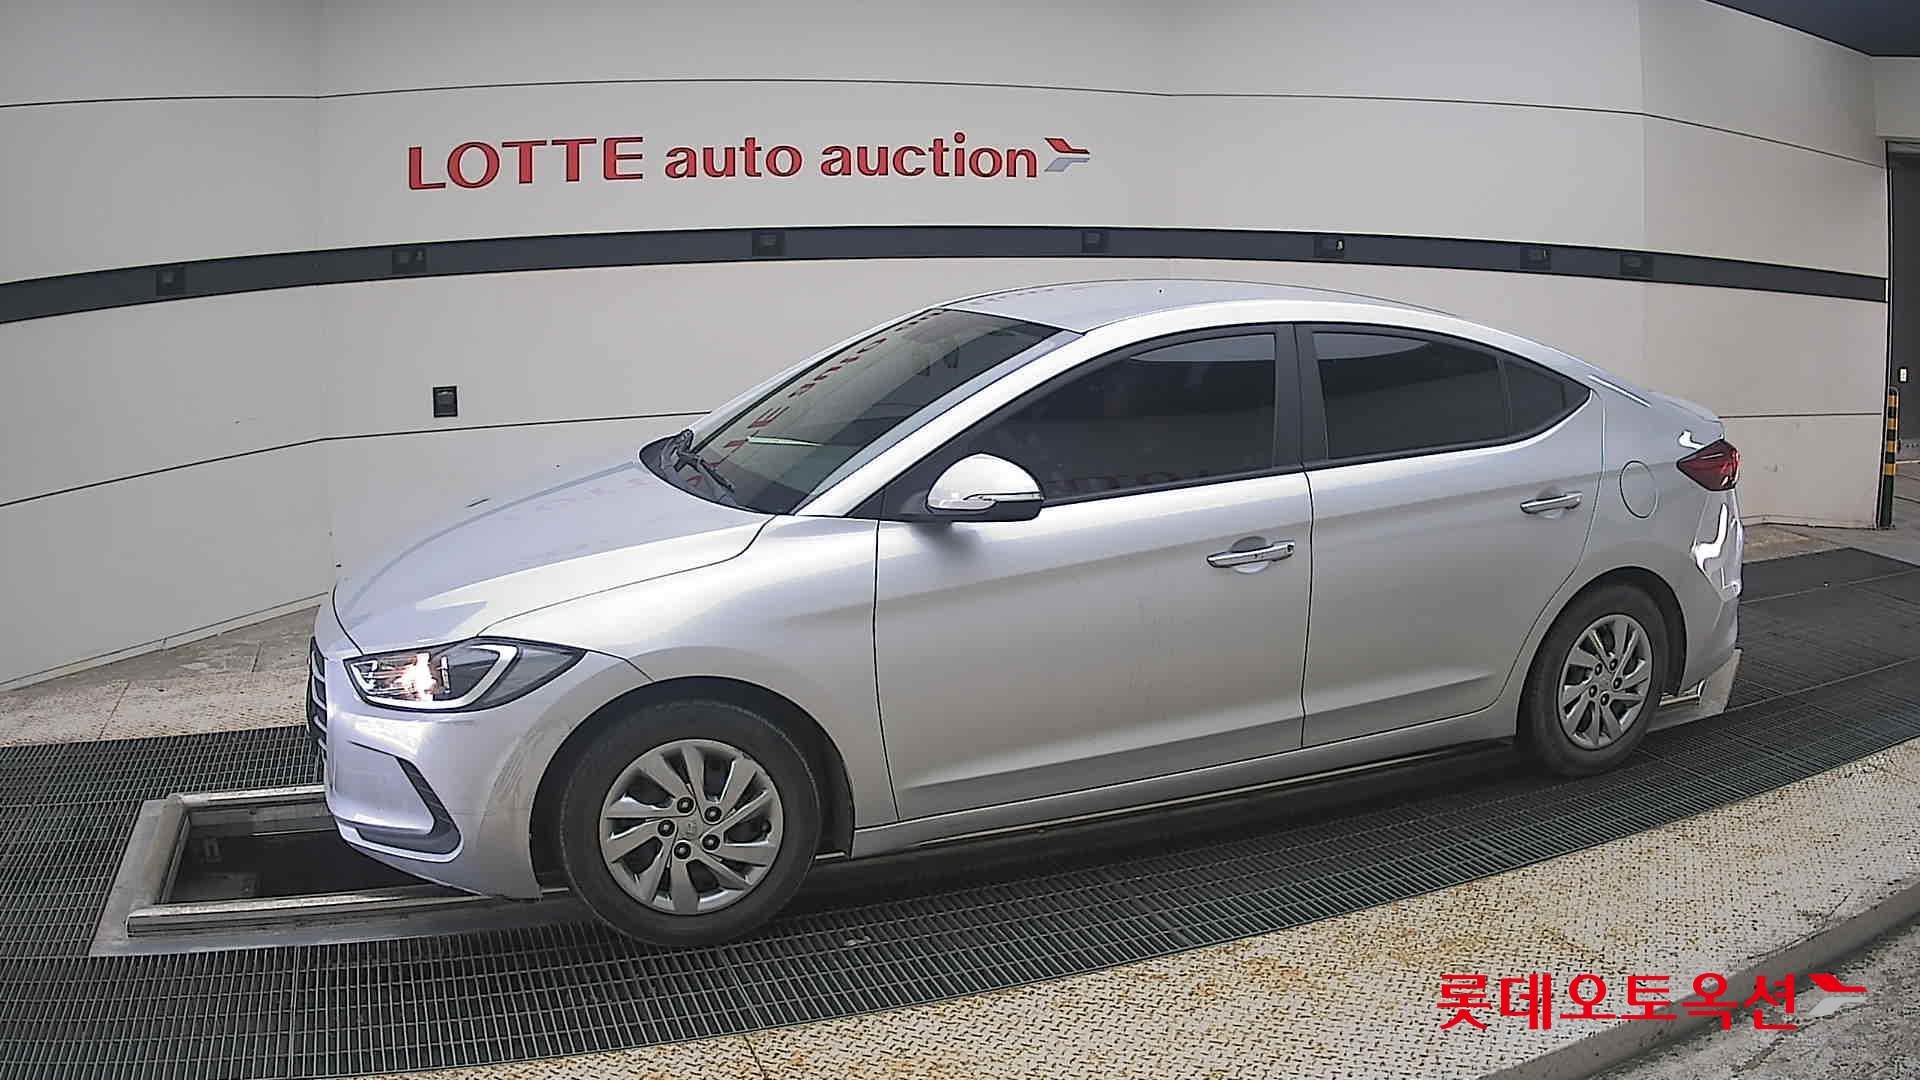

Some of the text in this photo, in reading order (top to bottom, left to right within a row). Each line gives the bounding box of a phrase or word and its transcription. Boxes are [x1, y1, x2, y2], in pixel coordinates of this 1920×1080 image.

[408, 132, 1038, 190] LOTTE auto auction
